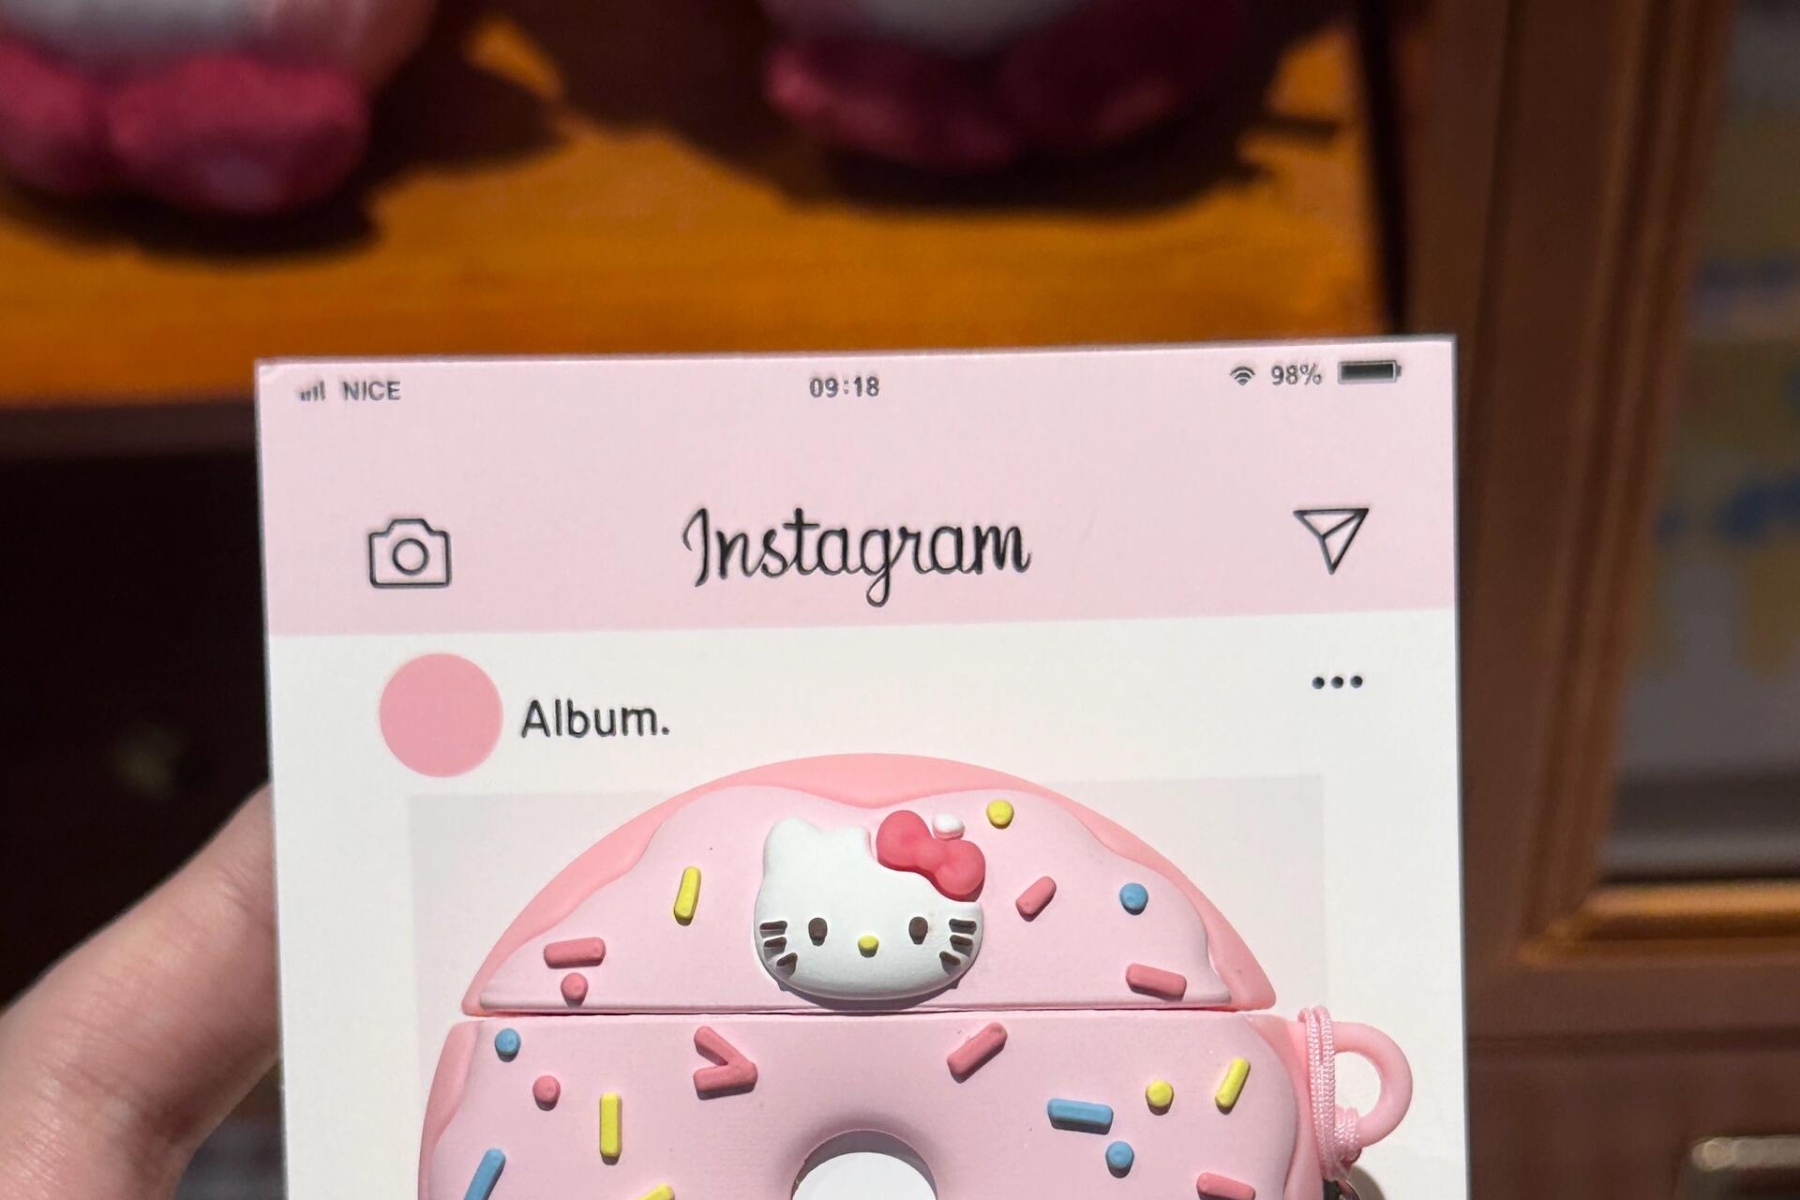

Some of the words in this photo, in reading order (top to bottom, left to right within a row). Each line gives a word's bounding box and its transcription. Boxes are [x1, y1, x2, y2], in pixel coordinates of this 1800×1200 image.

[1270, 363, 1323, 386] 98%
[342, 380, 402, 401] NICE
[809, 376, 881, 398] 09:18
[682, 507, 1032, 607] Instagram
[521, 699, 671, 739] Album.
